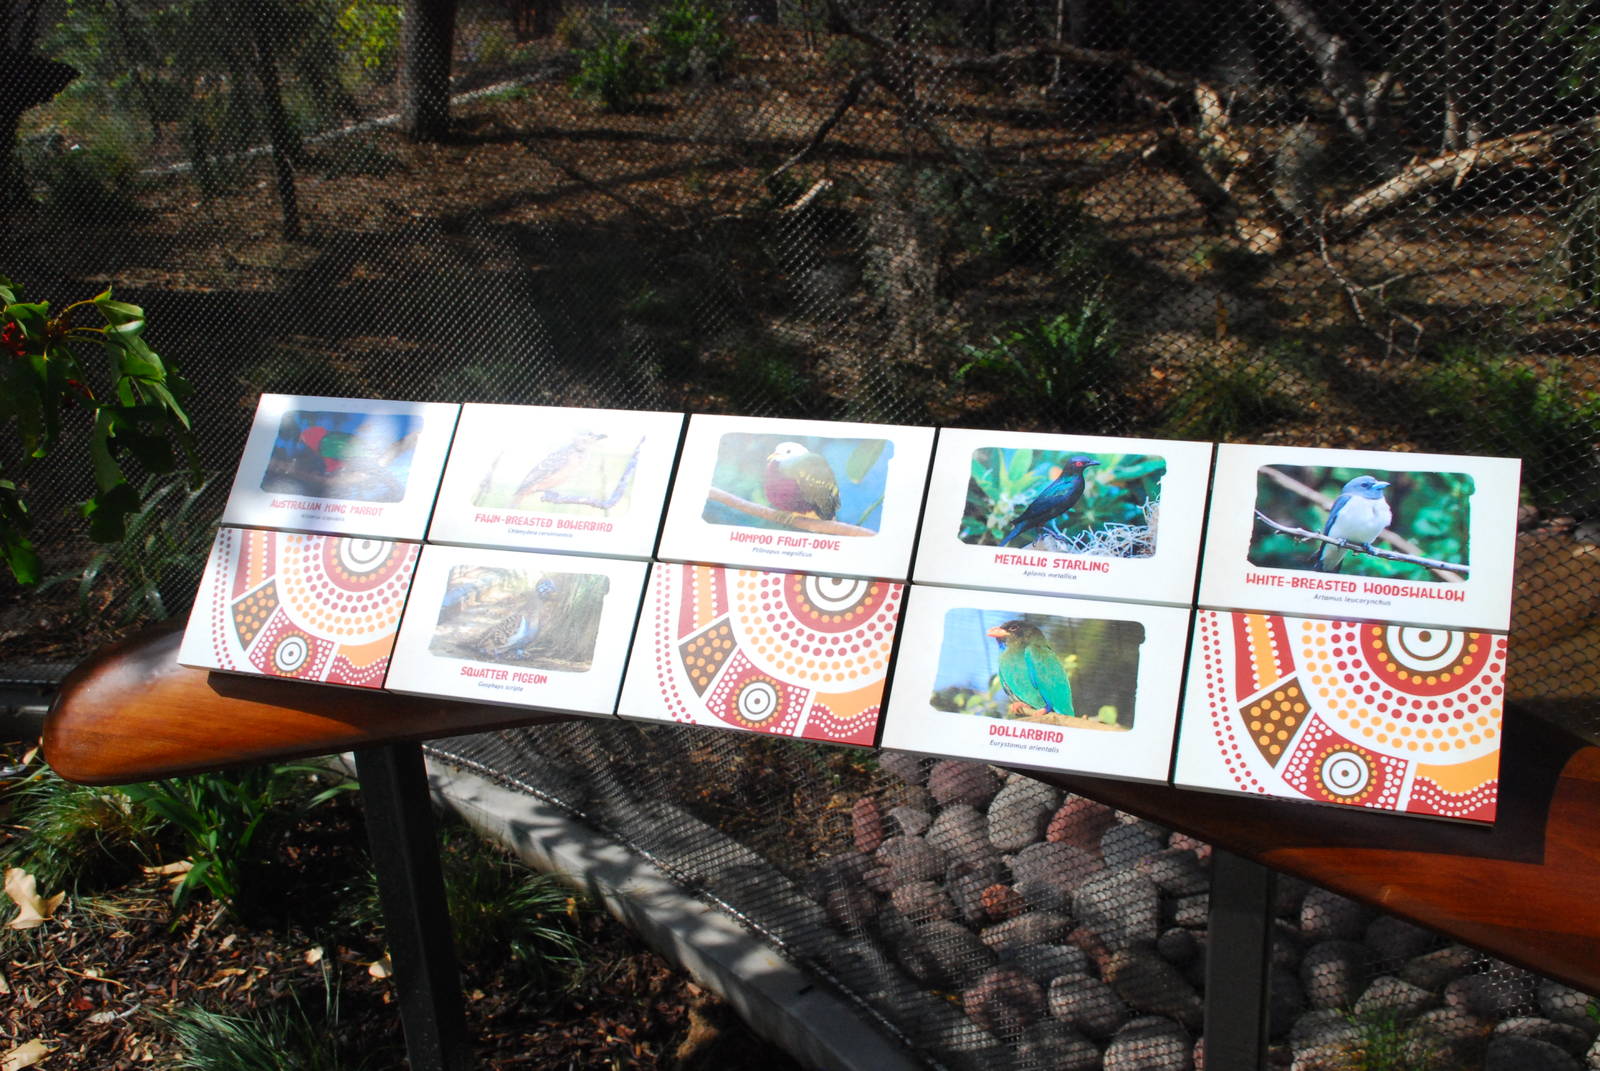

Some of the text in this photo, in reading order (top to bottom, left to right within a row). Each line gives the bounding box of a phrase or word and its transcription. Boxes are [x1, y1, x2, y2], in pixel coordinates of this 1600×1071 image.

[270, 499, 321, 511] AUSTRALIAN
[324, 503, 347, 514] KING
[350, 506, 384, 517] PARROT
[474, 513, 613, 533] FAWN-BREASTED BOWERBIRD
[730, 531, 841, 551] WOMPOO FRUIT-DOVE
[994, 553, 1110, 573] METALLIC STARLING
[1245, 572, 1465, 602] WHITE-BREASTED WOODSWALLOW
[1313, 593, 1343, 603] Artamus
[460, 666, 548, 684] SQUATTER PIGEON
[989, 724, 1064, 743] DOLLARBIRD
[989, 739, 1060, 754] Eurystomus orientalis
